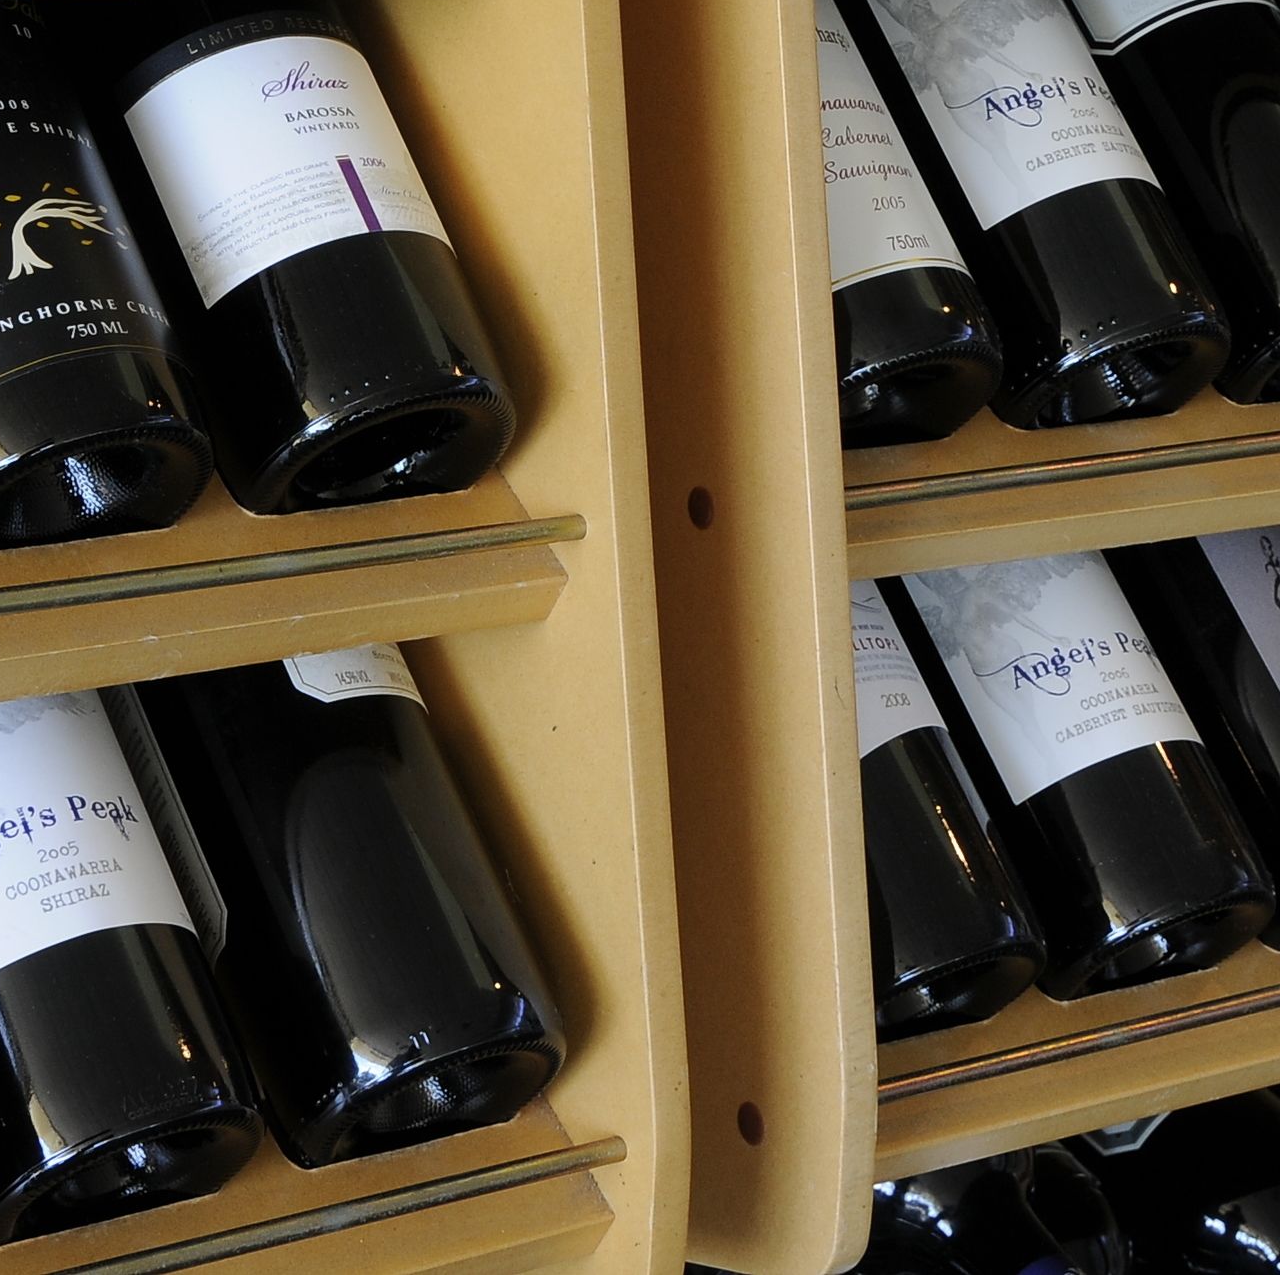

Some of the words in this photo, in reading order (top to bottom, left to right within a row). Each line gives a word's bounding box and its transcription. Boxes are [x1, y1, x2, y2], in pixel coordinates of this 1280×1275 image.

[14, 24, 33, 40] 10
[185, 18, 275, 56] LIMITED
[261, 60, 350, 102] Shiraz
[284, 105, 355, 123] BAROSSA
[982, 77, 1081, 127] Angel's
[294, 121, 360, 135] VINEYARDS
[359, 157, 386, 168] 2006
[1026, 142, 1098, 172] CABERNET
[823, 159, 913, 184] Sauvignon
[871, 195, 906, 211] 2005
[886, 234, 931, 251] 750ml
[67, 322, 97, 340] 750
[102, 320, 129, 336] ML
[1012, 637, 1112, 697] Angel's
[880, 693, 911, 708] 2008
[1079, 683, 1159, 712] COONAWARRA
[1055, 707, 1127, 744] CABERNET
[64, 794, 139, 842] Peak
[37, 841, 80, 863] 2005
[4, 857, 123, 901] COONAWARRA
[39, 883, 110, 914] SHIRAZ
